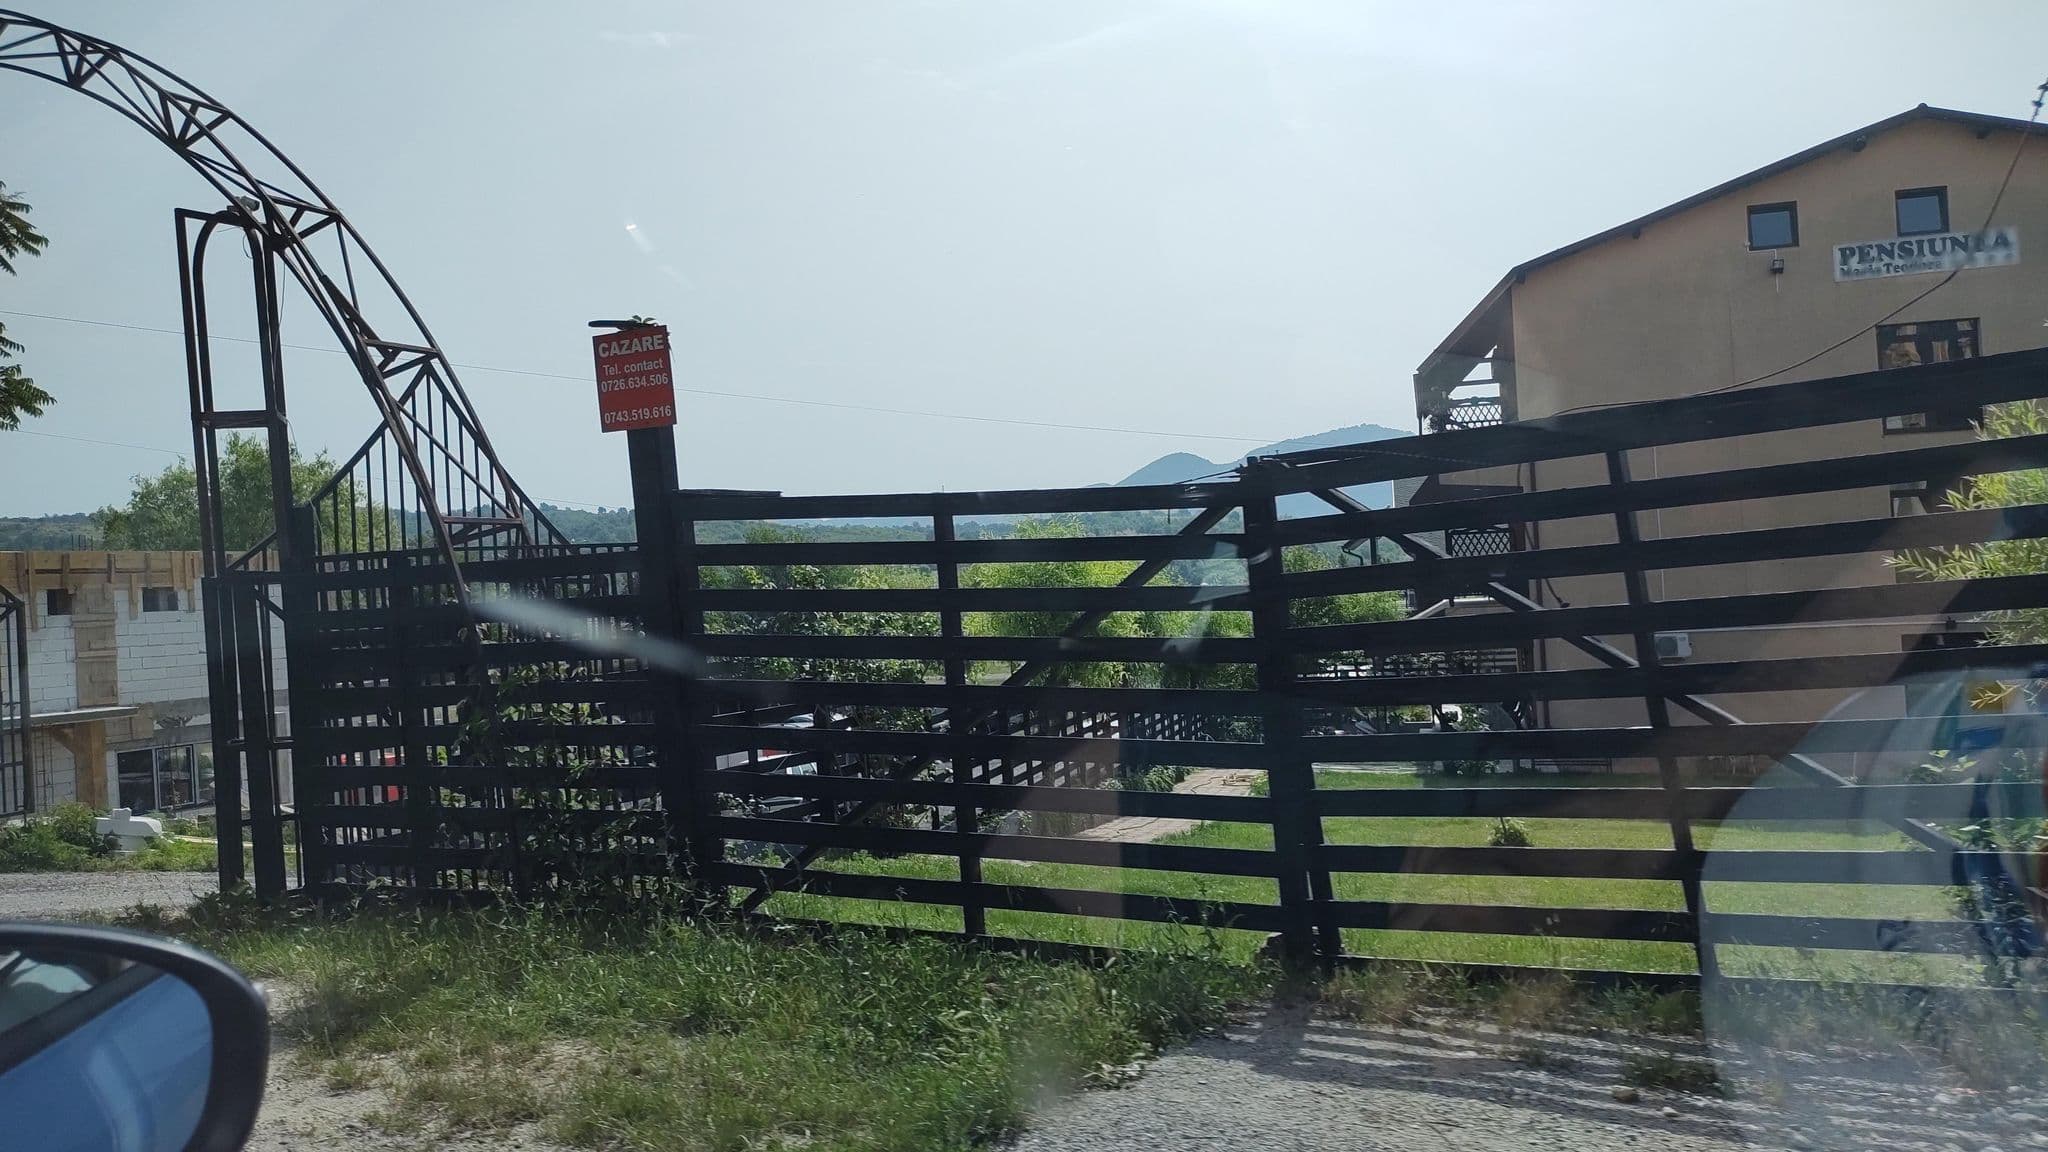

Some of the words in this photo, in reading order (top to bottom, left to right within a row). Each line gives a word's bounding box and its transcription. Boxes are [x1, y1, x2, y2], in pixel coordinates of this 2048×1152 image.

[598, 334, 665, 358] CAZARE
[602, 364, 622, 376] Tel.
[624, 358, 664, 373] contact
[601, 373, 669, 392] 0726.634.506
[604, 405, 672, 424] 0743.519.616
